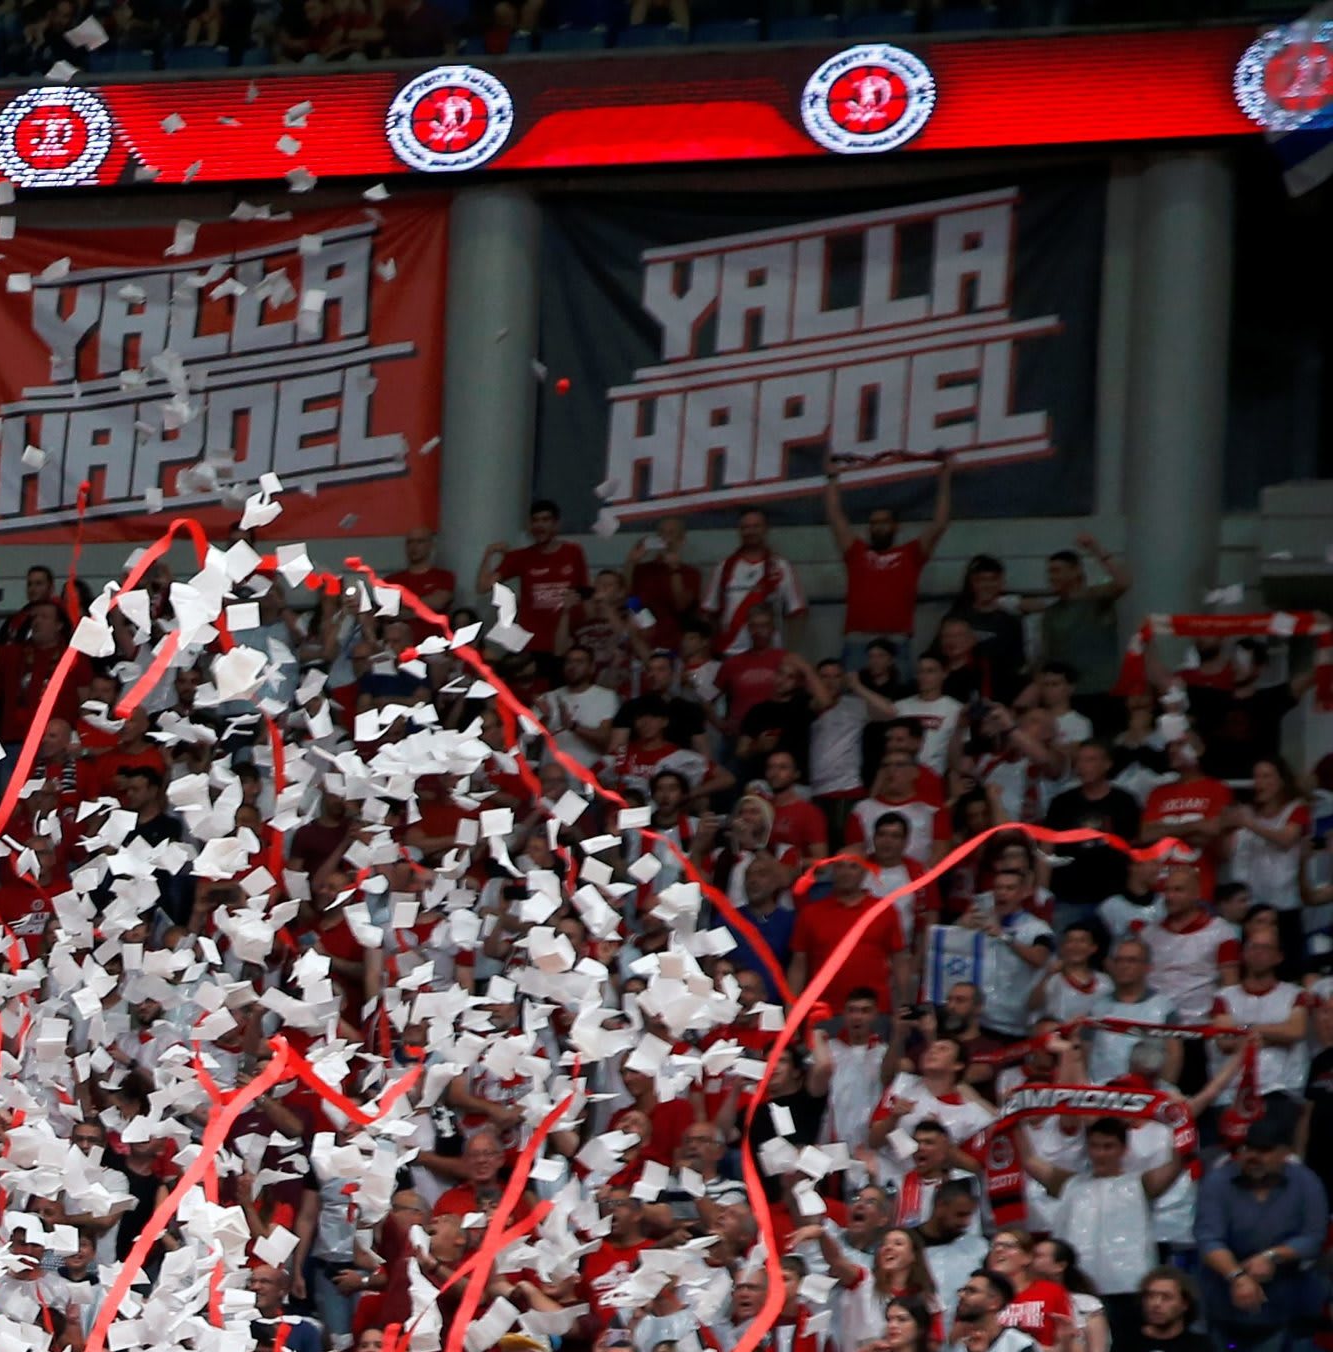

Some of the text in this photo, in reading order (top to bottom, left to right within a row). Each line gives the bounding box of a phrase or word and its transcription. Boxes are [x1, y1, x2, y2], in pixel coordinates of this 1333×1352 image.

[642, 203, 1014, 361] YALLA
[608, 340, 1050, 503] HAPOEL
[1004, 1088, 1152, 1113] AMPIONS
